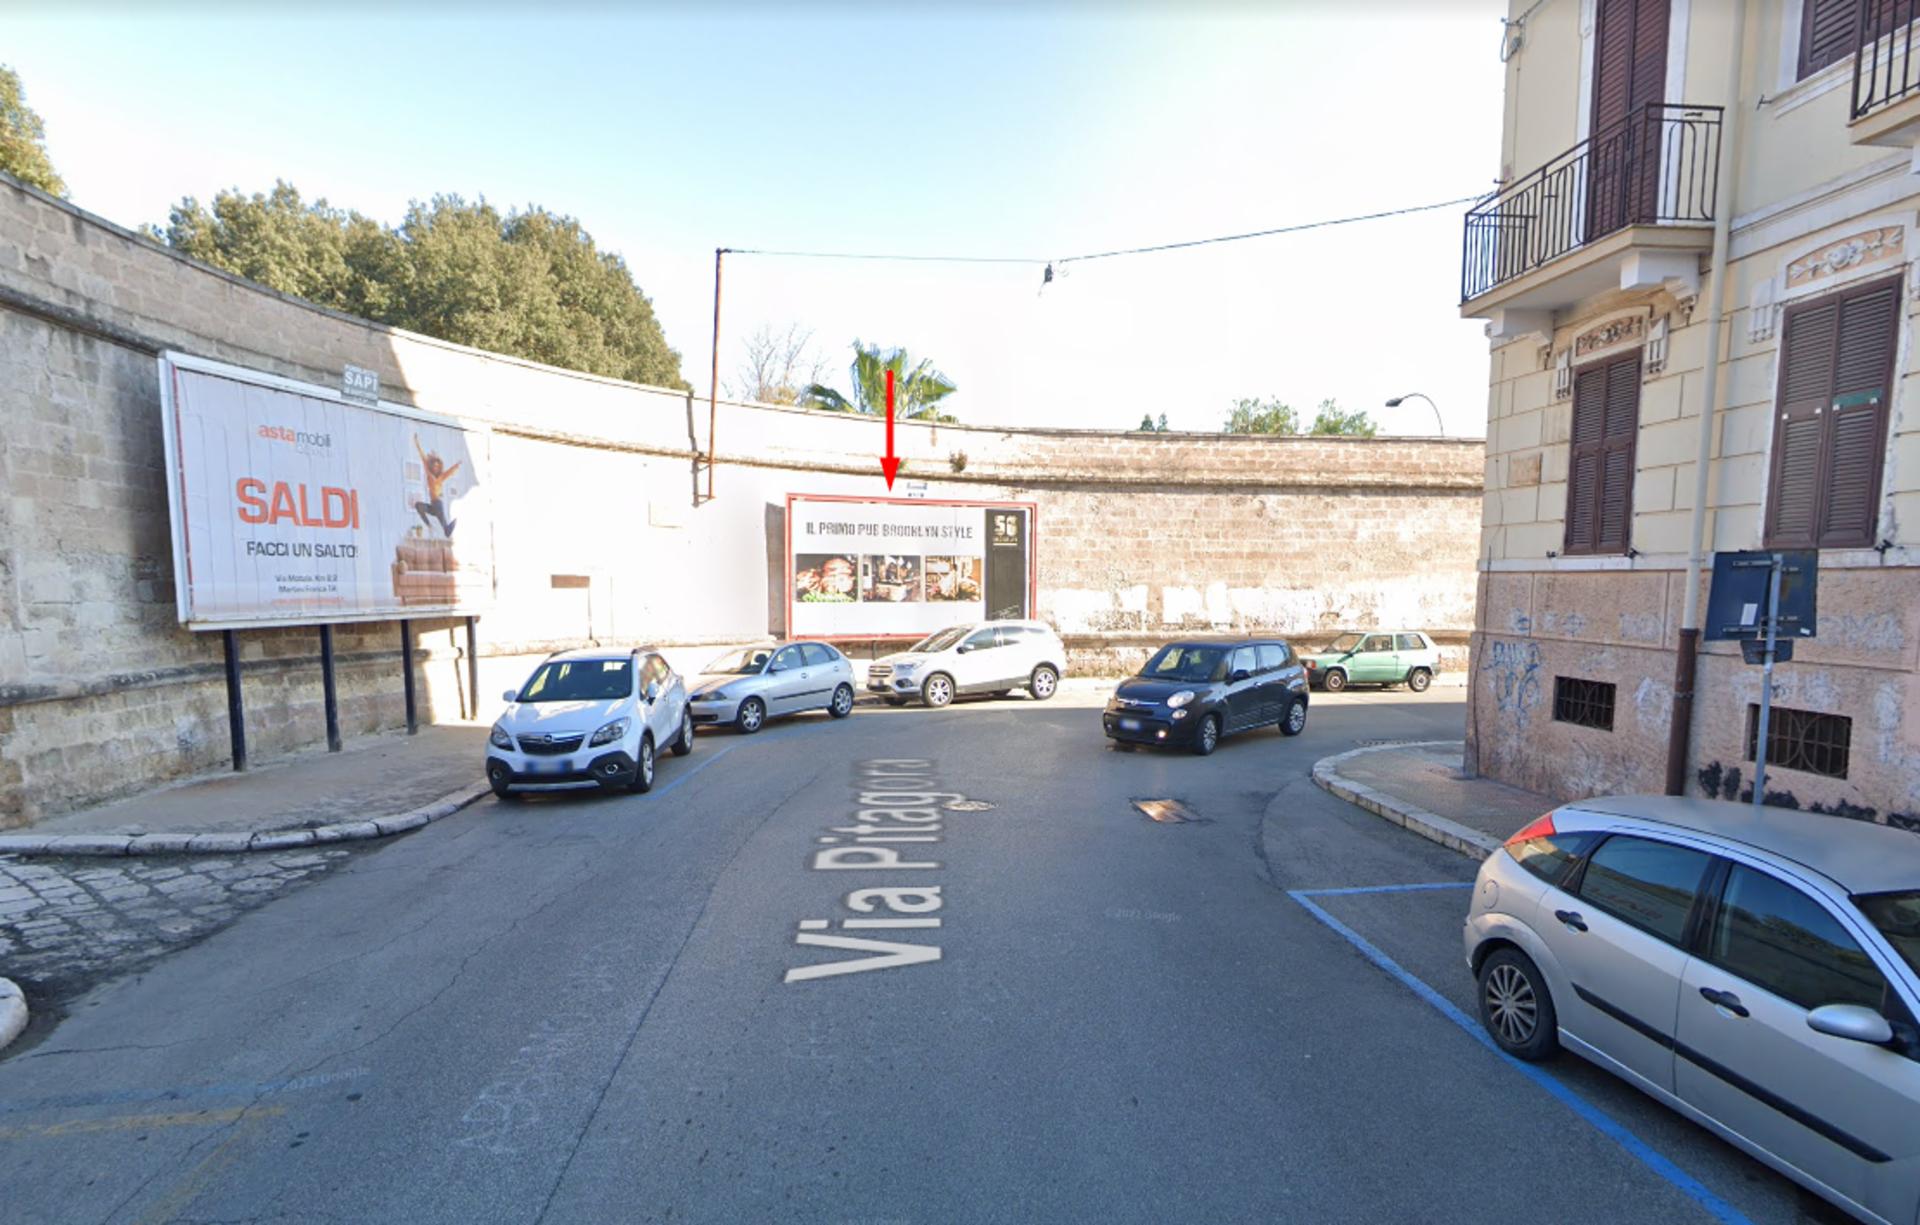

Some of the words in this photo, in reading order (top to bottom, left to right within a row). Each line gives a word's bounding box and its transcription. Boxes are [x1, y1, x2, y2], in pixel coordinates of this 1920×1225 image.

[236, 477, 360, 529] SALDI
[806, 522, 815, 535] IL
[819, 522, 855, 536] PRIMO
[857, 523, 879, 537] PUB
[882, 523, 939, 538] BROOKLYN
[941, 525, 974, 539] STYLE
[246, 541, 289, 557] FACCI
[293, 543, 312, 557] UN
